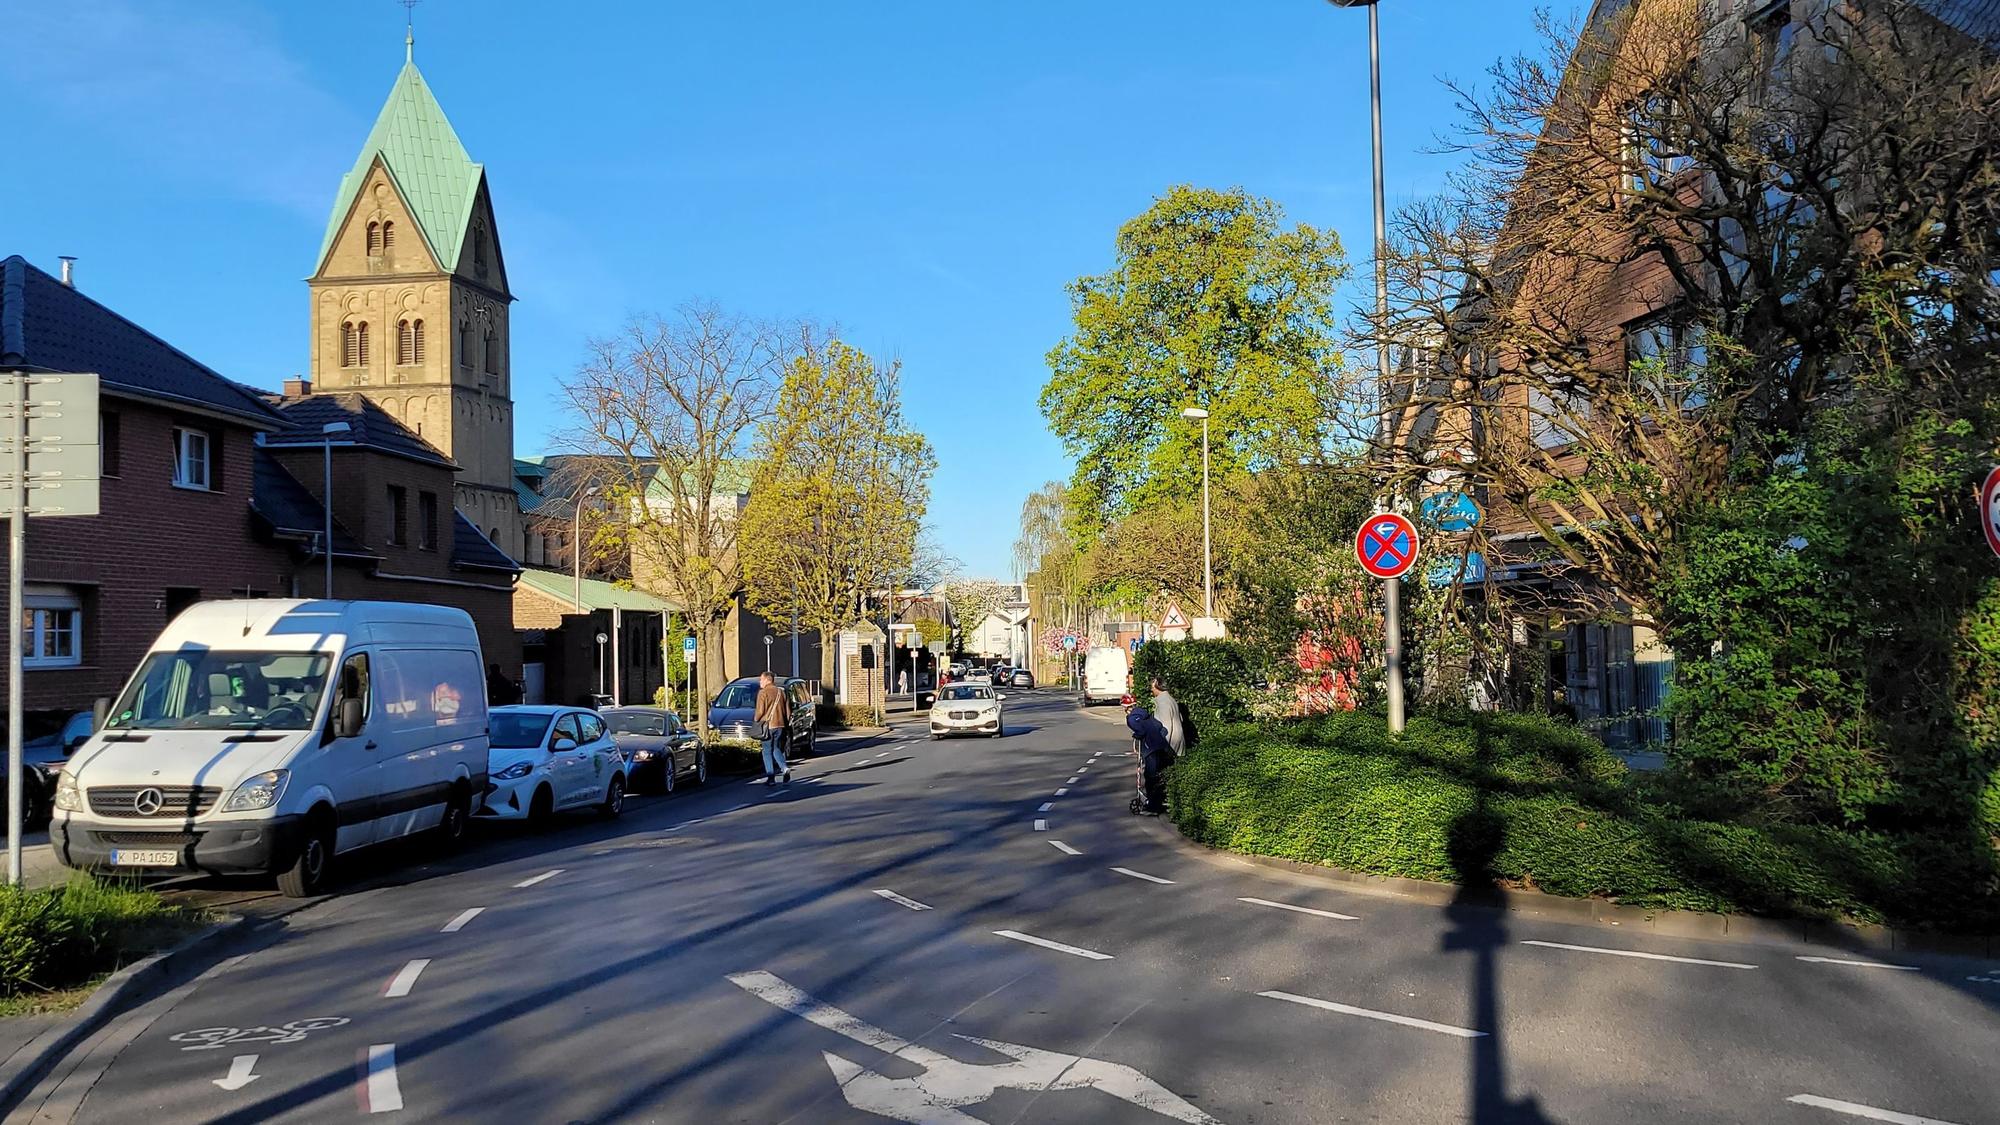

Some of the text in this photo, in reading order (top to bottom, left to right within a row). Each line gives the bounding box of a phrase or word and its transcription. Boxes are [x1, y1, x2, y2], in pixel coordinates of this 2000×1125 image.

[155, 599, 162, 609] 7
[686, 640, 693, 649] P
[118, 852, 175, 863] K PA 1052
